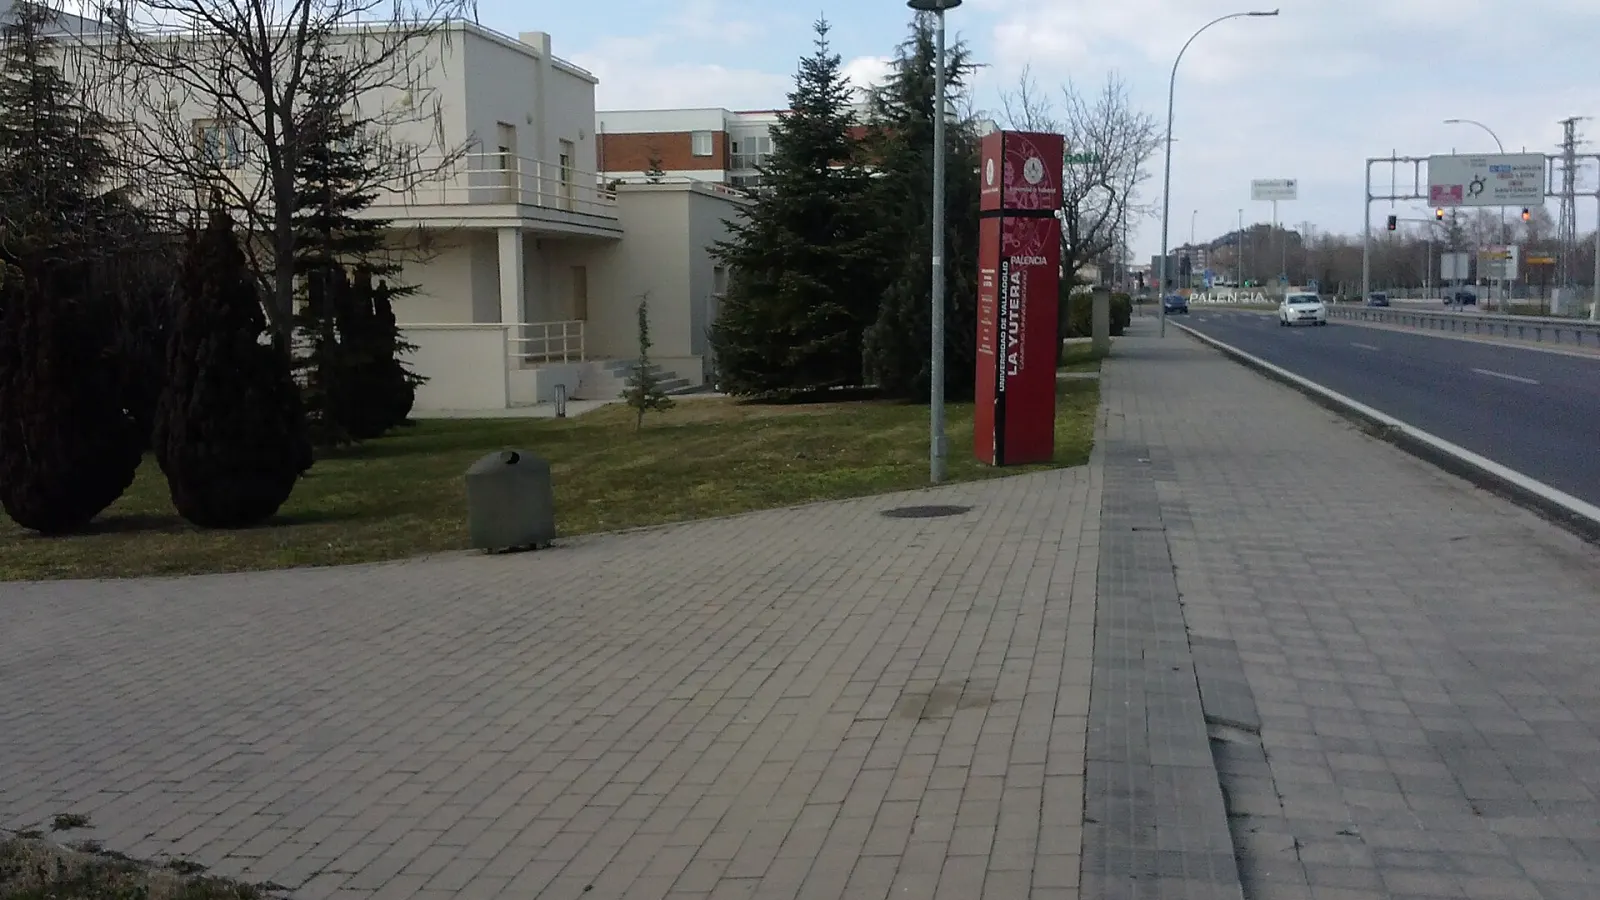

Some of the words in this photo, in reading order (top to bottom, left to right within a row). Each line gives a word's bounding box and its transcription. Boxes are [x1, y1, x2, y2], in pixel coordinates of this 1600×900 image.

[1010, 255, 1047, 266] PALENCIA
[1001, 261, 1009, 316] VALLADOLID
[1189, 289, 1267, 304] PALENCIA
[1008, 271, 1021, 348] YUTERA
[1000, 317, 1007, 330] DE
[1007, 352, 1018, 376] LA
